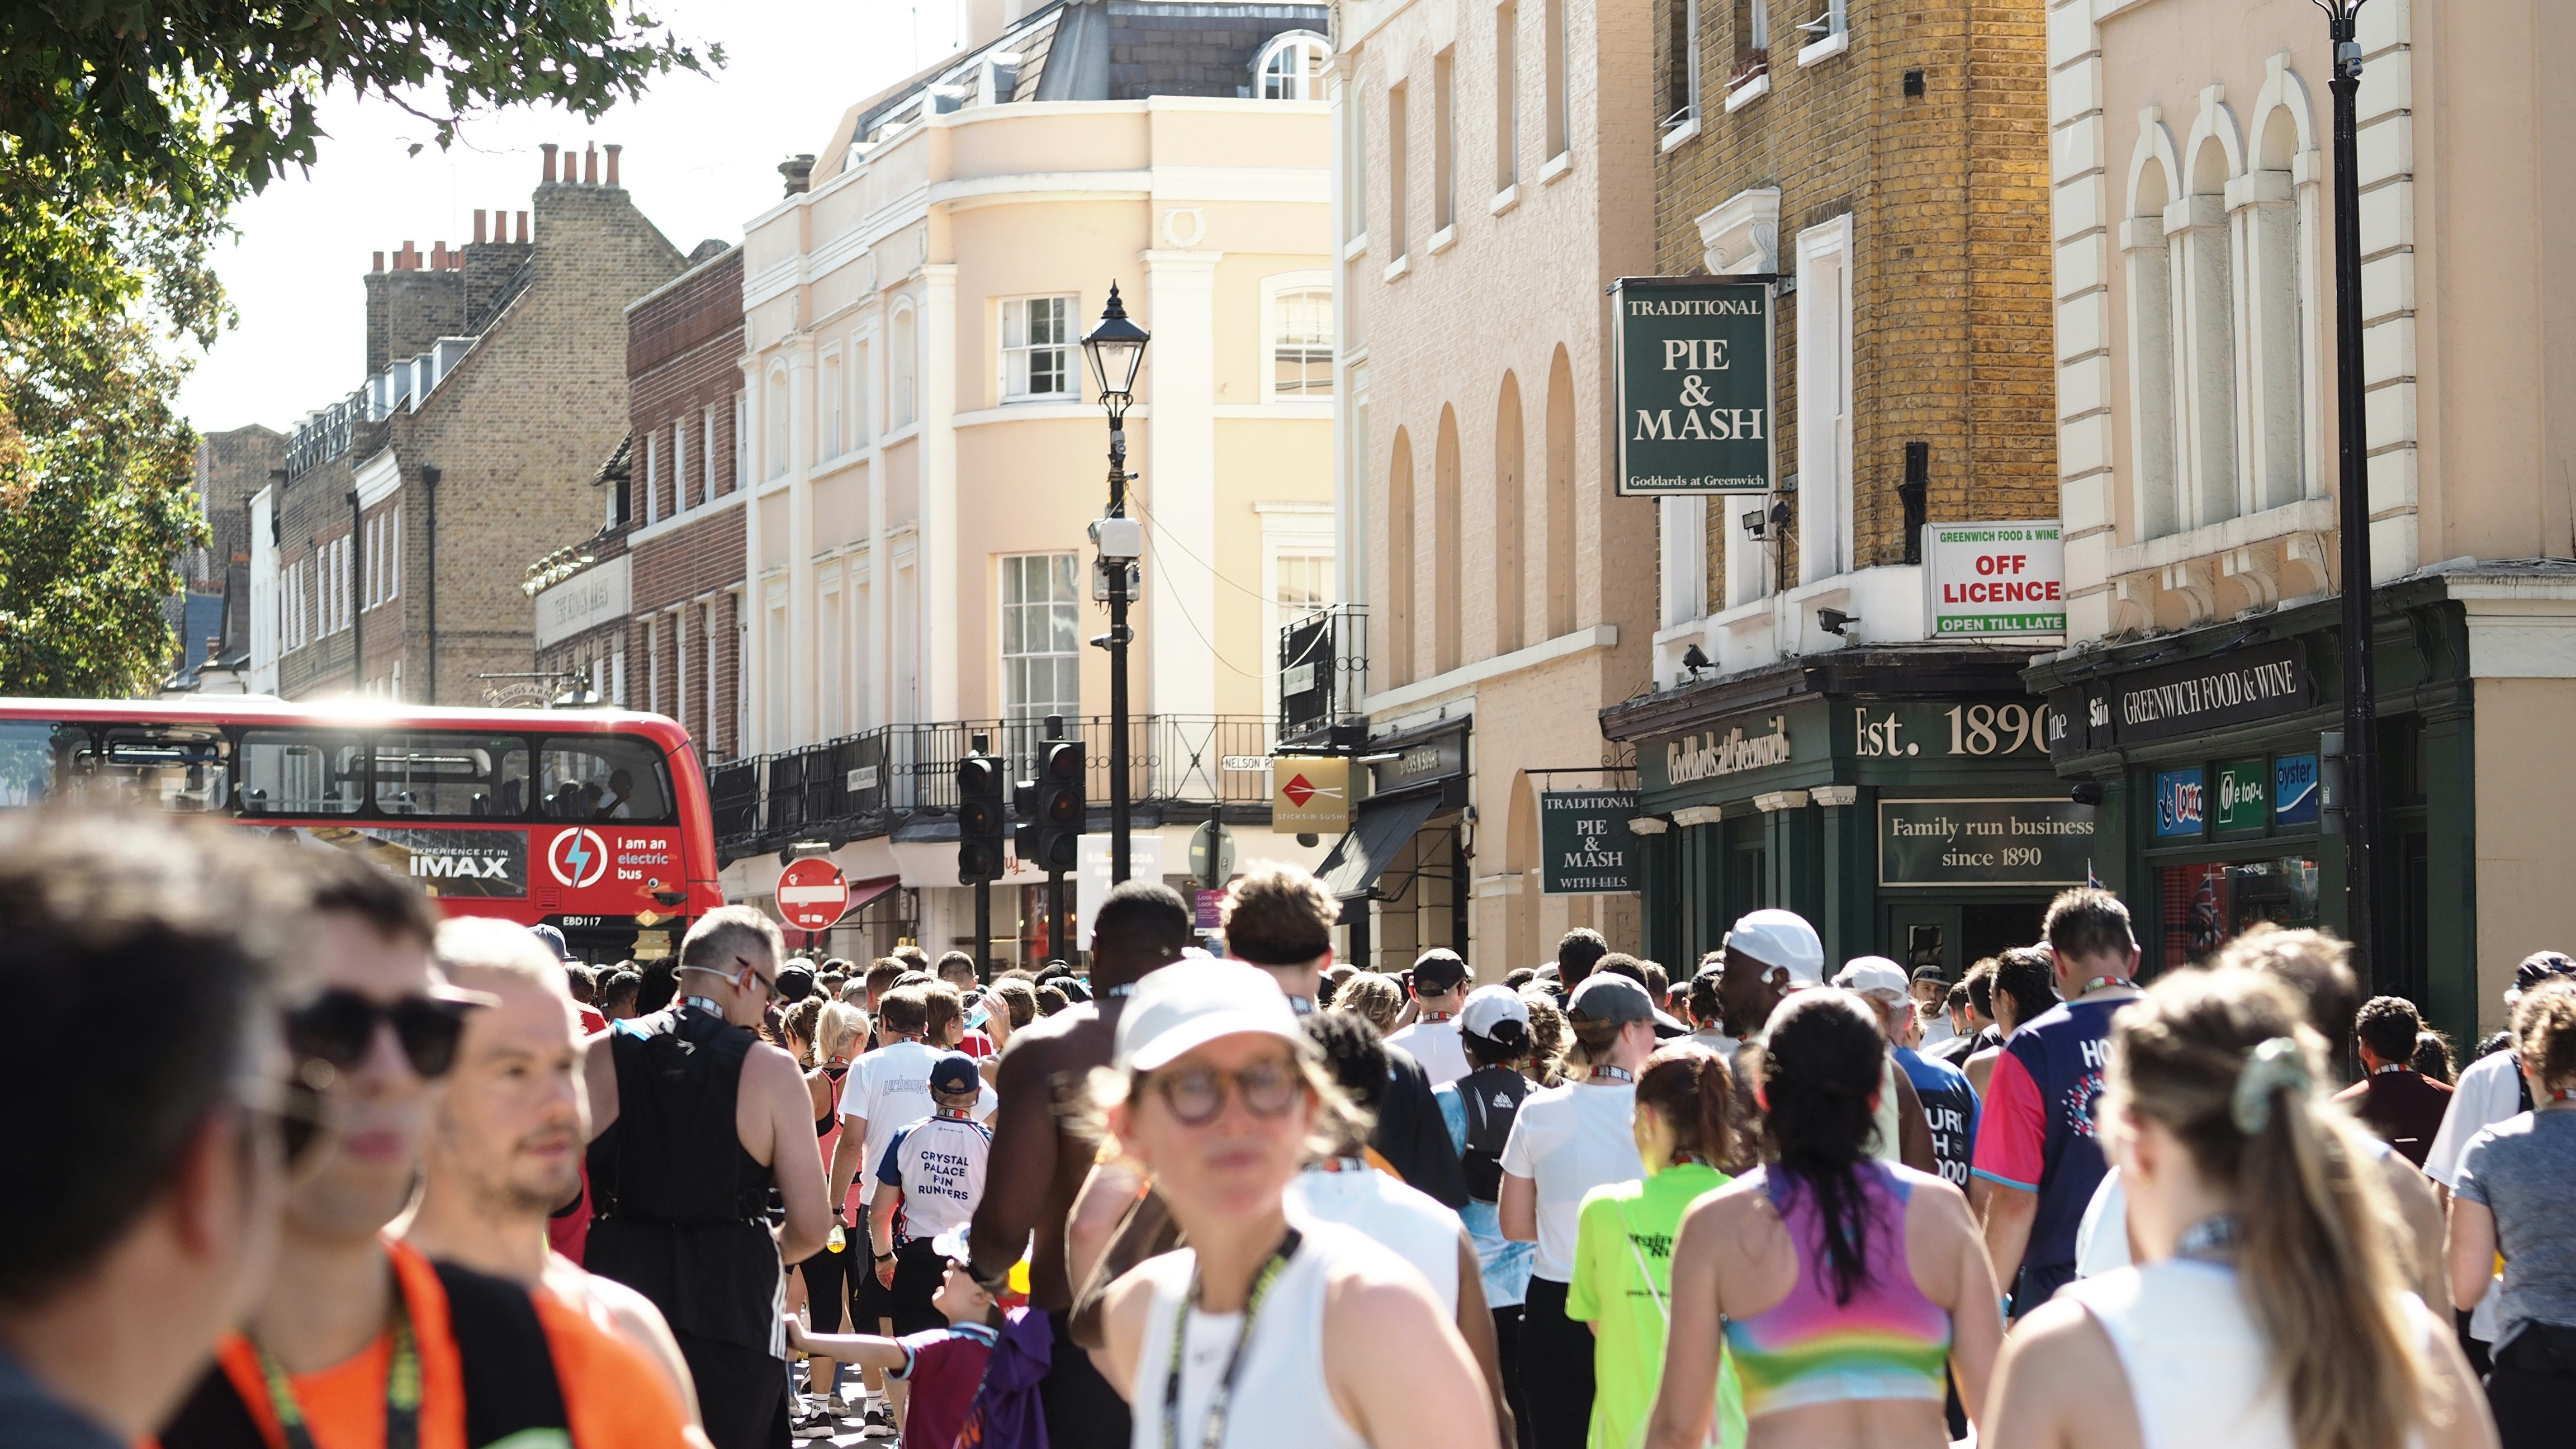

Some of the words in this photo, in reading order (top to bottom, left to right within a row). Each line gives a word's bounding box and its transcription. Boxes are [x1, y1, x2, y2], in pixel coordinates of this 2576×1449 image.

[1628, 300, 1761, 315] TRADITIONAL
[1663, 340, 1730, 370] PIE
[1679, 375, 1714, 406] &
[1633, 409, 1764, 440] MASH
[1630, 475, 1687, 486] Goddards
[1690, 477, 1701, 486] at
[1704, 475, 1764, 486] Greenwich
[1940, 532, 1995, 542] GREENWICH
[1998, 531, 2023, 541] FOOD
[2025, 530, 2033, 541] &
[2035, 529, 2059, 540] WINE
[1976, 555, 2026, 575] OFF
[1944, 581, 2061, 603] LICENCE
[1942, 619, 1984, 631] OPEN
[1988, 618, 2021, 630] TILL
[2025, 617, 2062, 629] LATE
[2124, 680, 2201, 724] GREENWICH
[2200, 672, 2241, 709] FOOD
[2243, 669, 2257, 702] &
[2253, 660, 2296, 699] WINE
[2090, 698, 2109, 727] Sun
[1855, 707, 1920, 756] Est.
[2048, 707, 2067, 741] ine
[1668, 731, 1717, 785] Goddards
[1718, 735, 1732, 775] at
[1730, 716, 1790, 772] Greenwich
[1225, 757, 1260, 769] NELSON
[1265, 758, 1275, 769] RO
[2277, 760, 2312, 792] oyster
[2242, 781, 2264, 804] top-u
[1545, 797, 1638, 809] TRADITIONAL
[2175, 783, 2203, 823] Lotto
[1576, 820, 1608, 835] PIE
[1892, 817, 1959, 843] Family
[1966, 820, 2004, 835] run
[2011, 816, 2094, 835] business
[618, 837, 622, 849] I
[626, 840, 646, 849] am
[650, 840, 667, 849] an
[1584, 836, 1600, 851] &
[618, 852, 669, 864] electric
[1564, 851, 1623, 868] MASH
[1942, 847, 1994, 866] since
[2002, 847, 2042, 866] 1890
[410, 856, 509, 878] IMAX
[618, 868, 642, 879] bus
[1560, 877, 1595, 888] WITH
[562, 916, 601, 926] EBD117
[2080, 1039, 2114, 1068] HO
[921, 1151, 969, 1166] CRYSTAL
[924, 1162, 965, 1177] PALACE
[934, 1175, 953, 1187] FUN
[918, 1186, 968, 1200] RUNNERS
